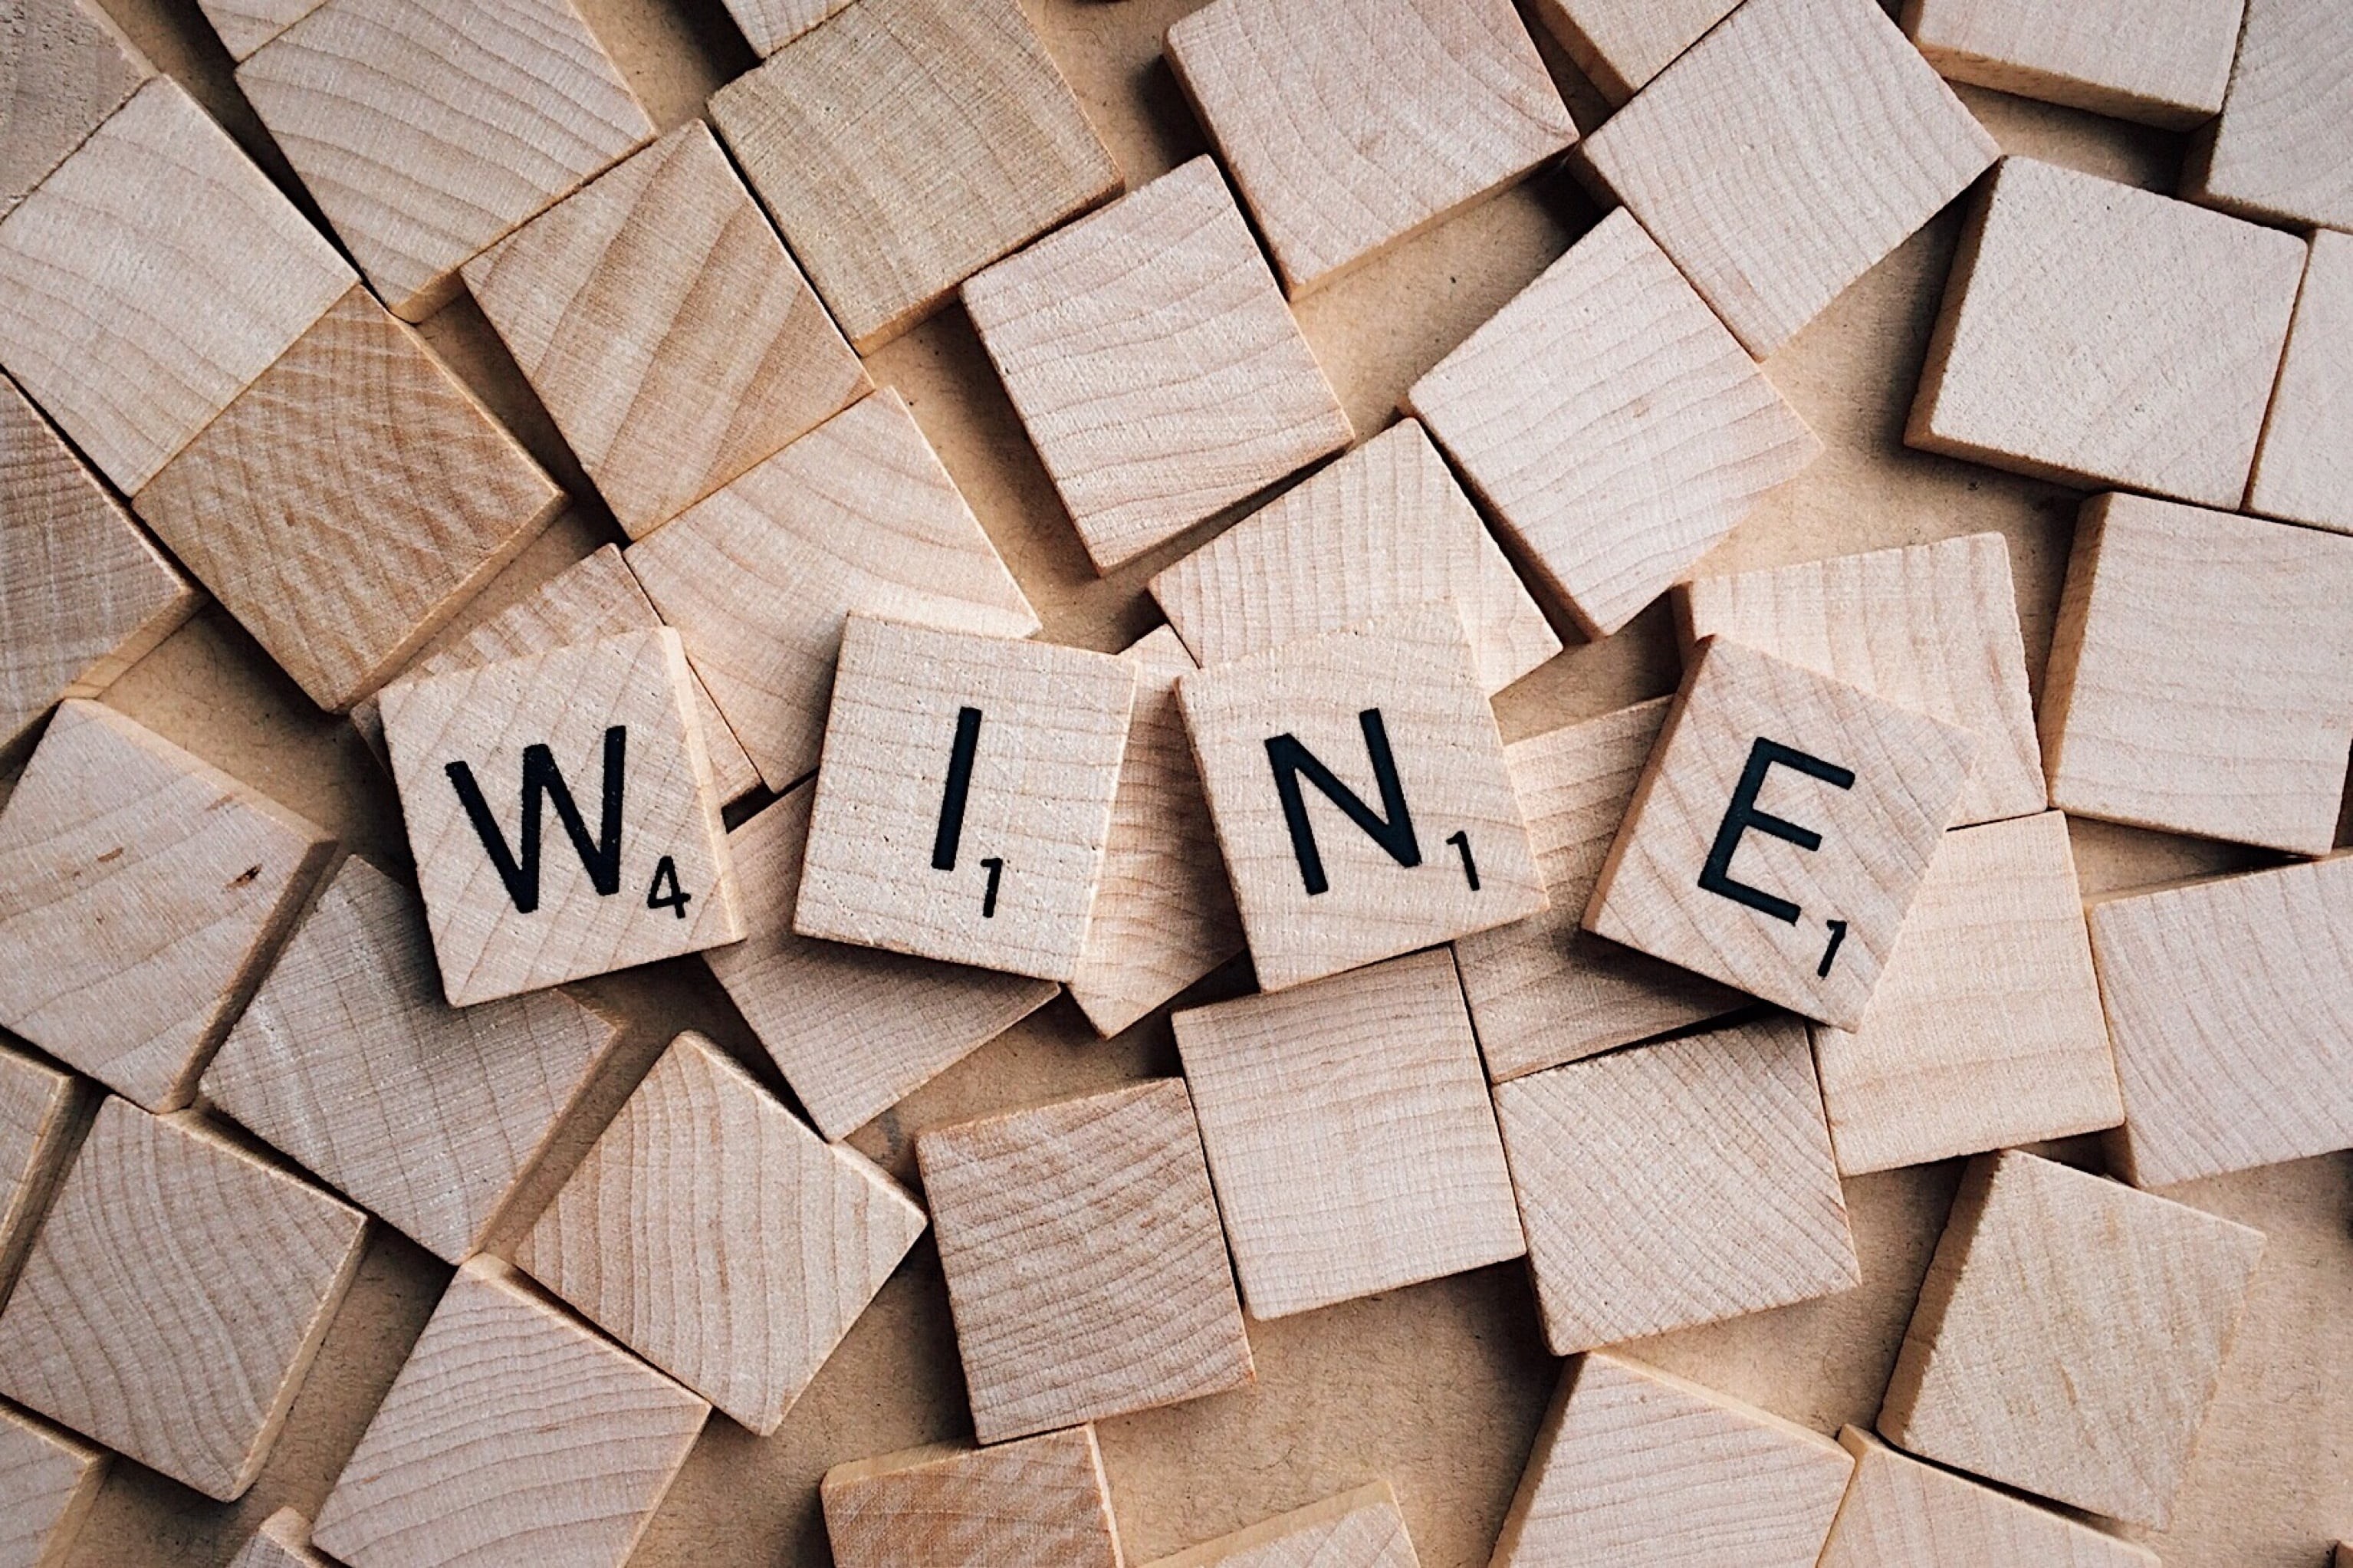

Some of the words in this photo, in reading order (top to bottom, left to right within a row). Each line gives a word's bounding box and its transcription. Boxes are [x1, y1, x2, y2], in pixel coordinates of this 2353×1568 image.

[646, 856, 692, 919] 4
[980, 857, 1004, 919] 1
[1445, 830, 1480, 892] 1
[1817, 919, 1848, 978] 1
